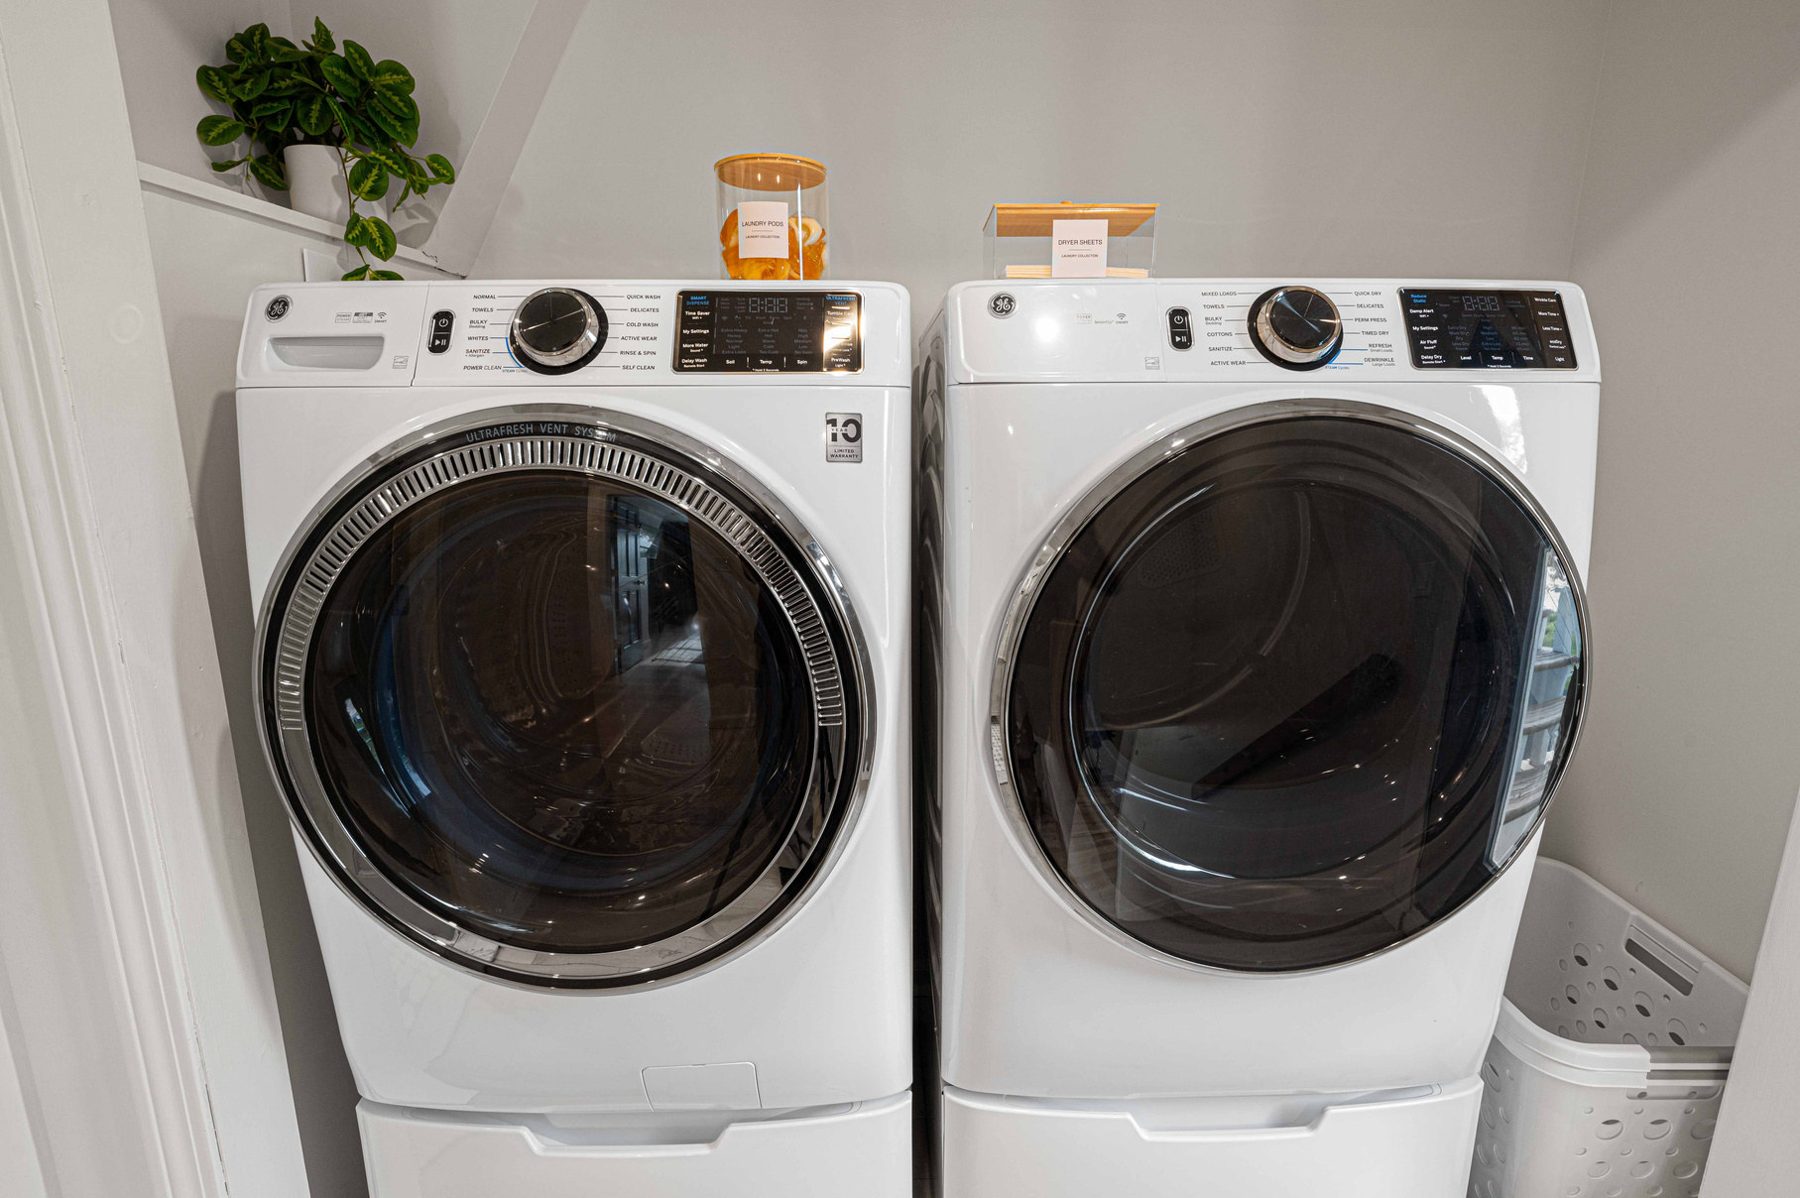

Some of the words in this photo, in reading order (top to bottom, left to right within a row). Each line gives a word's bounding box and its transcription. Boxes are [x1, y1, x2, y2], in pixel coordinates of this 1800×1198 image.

[466, 424, 534, 443] ULTRAFRESH
[540, 424, 568, 434] VENT
[826, 418, 861, 442] 10
